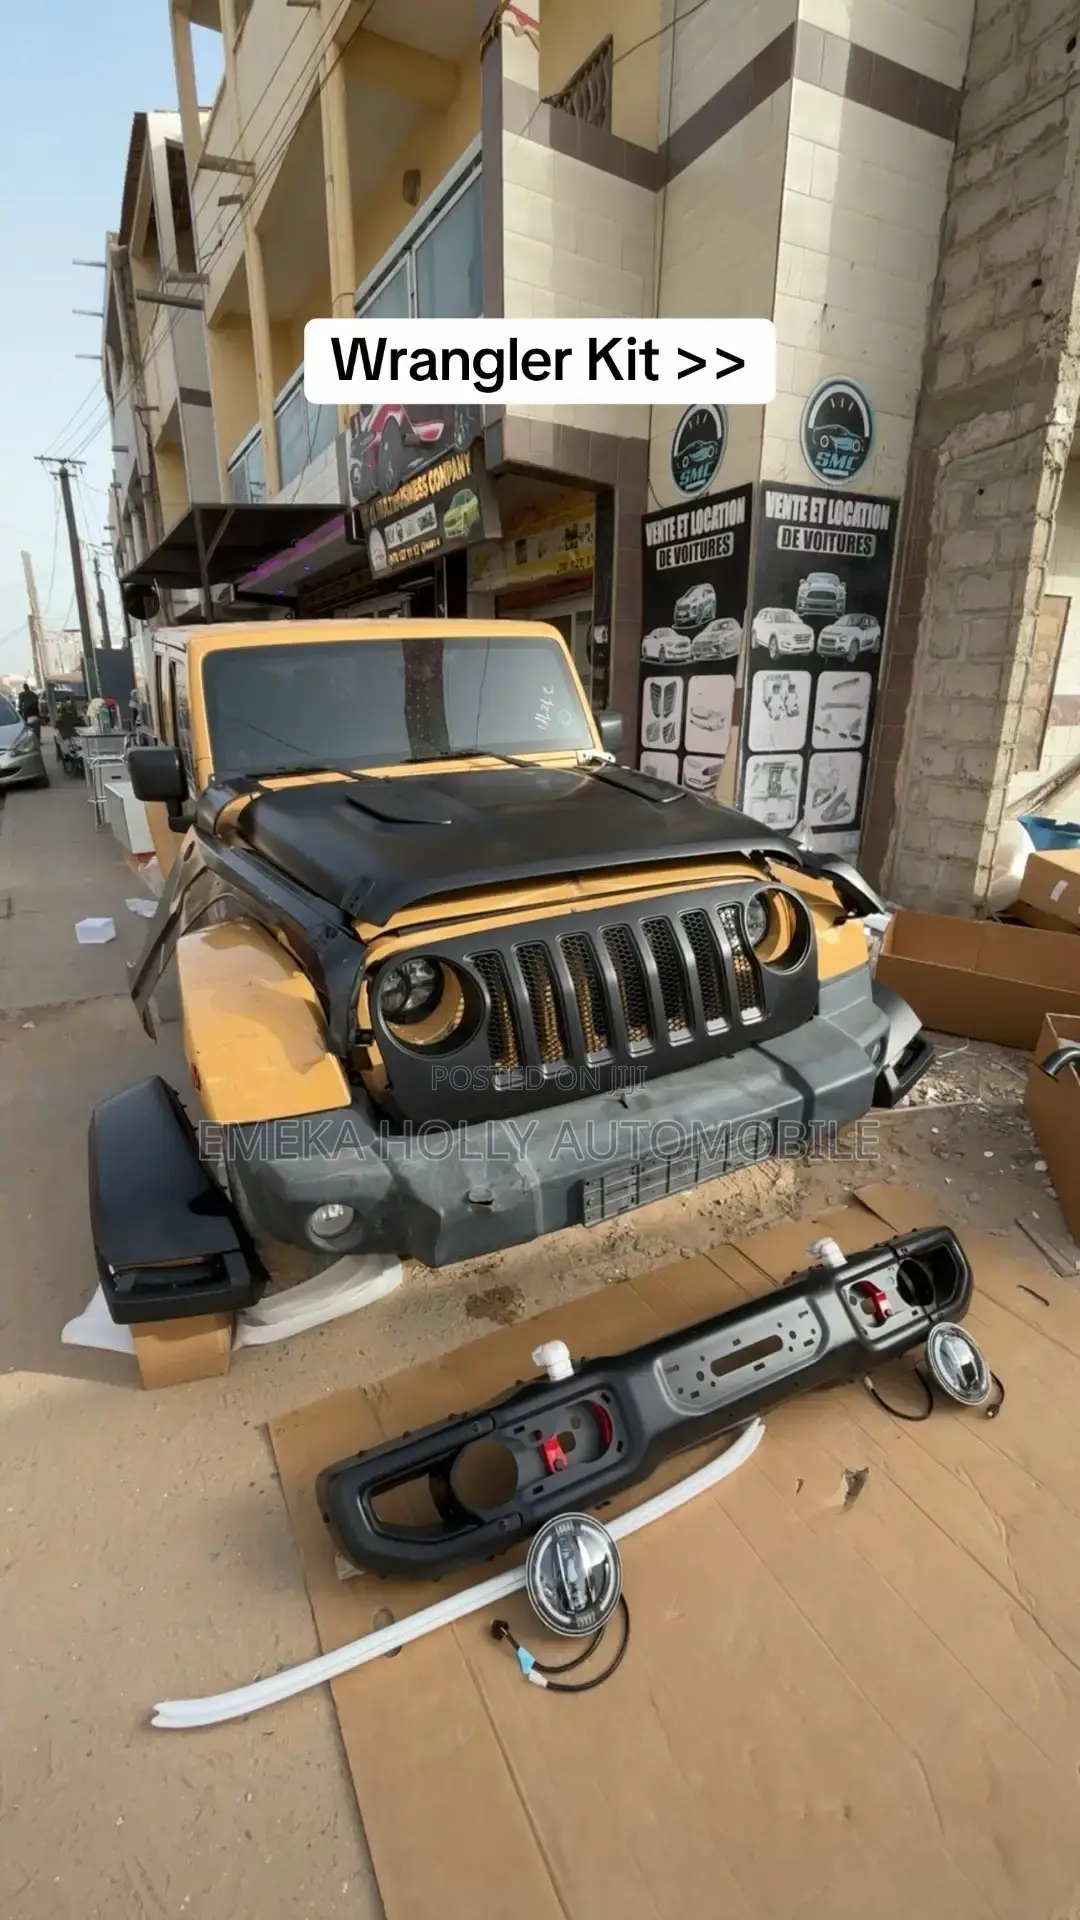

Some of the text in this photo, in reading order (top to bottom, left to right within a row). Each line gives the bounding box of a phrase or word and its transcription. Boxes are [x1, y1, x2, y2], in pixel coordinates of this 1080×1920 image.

[428, 450, 472, 495] COMPANY
[678, 462, 712, 486] SMC
[814, 451, 860, 472] SMC
[645, 496, 747, 547] VENTE ET LOCATION
[765, 490, 891, 530] VENTE ET LOCATION
[658, 535, 731, 569] DE VOITURES
[781, 528, 873, 555] DE VOITURES
